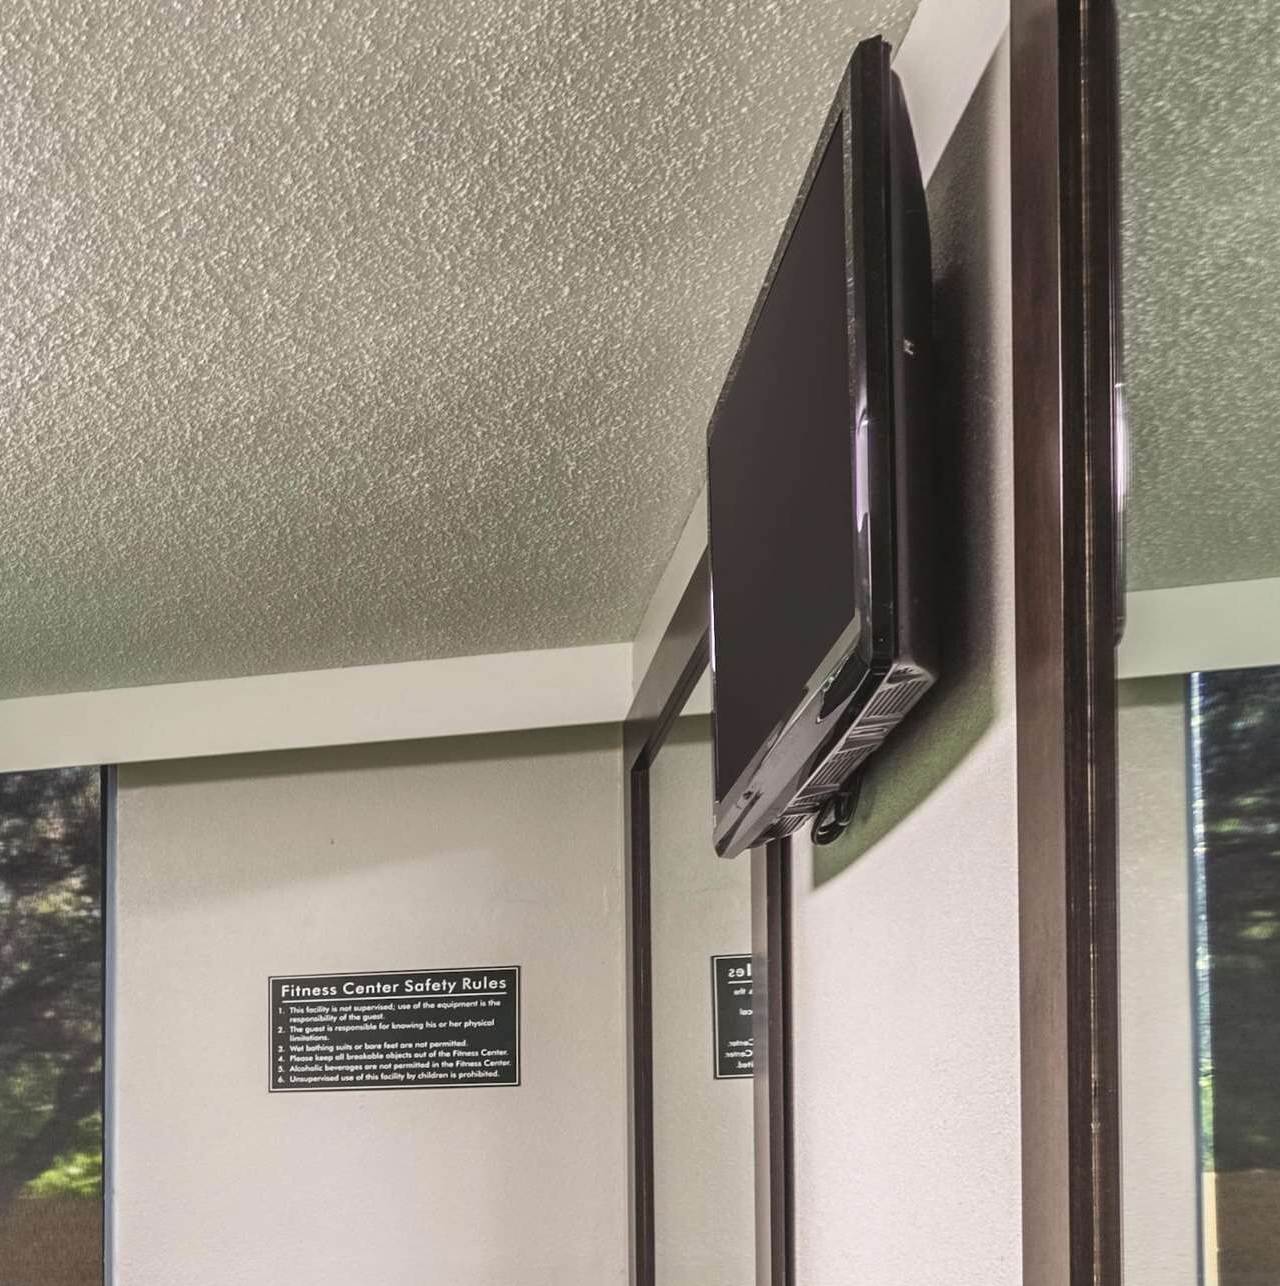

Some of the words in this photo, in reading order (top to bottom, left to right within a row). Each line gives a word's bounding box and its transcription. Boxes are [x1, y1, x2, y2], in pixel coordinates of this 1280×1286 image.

[282, 982, 337, 997] Fitness
[342, 980, 399, 995] Center
[404, 977, 456, 995] Safety
[462, 975, 506, 990] Rules
[289, 1006, 304, 1014] This
[305, 1005, 329, 1014] facility
[412, 1001, 421, 1009] of
[436, 1000, 478, 1009] equipment
[289, 1014, 337, 1024] responsibility
[338, 1013, 347, 1021] of
[289, 1025, 303, 1033] The
[304, 1025, 325, 1034] guest
[326, 1024, 333, 1032] is
[334, 1022, 377, 1032] responsible
[378, 1022, 389, 1030] for
[391, 1021, 423, 1031] knowing
[425, 1020, 436, 1028] his
[463, 1018, 494, 1028] physical
[277, 1045, 284, 1053] 3.
[289, 1044, 304, 1052] Wet
[305, 1043, 334, 1053] bathing
[364, 1042, 382, 1050] bare
[383, 1041, 398, 1049] feet
[289, 1054, 313, 1062] Please
[314, 1053, 333, 1062] keep
[345, 1051, 383, 1060] breakable
[385, 1051, 412, 1060] objects
[452, 1048, 478, 1057] Fitness
[289, 1064, 322, 1072] Alcoholic
[324, 1062, 362, 1073] beverages
[393, 1061, 430, 1070] permitted
[441, 1060, 453, 1068] the
[455, 1059, 481, 1067] Fitness
[277, 1075, 285, 1083] 6.
[289, 1074, 339, 1084] Unsupervised
[380, 1072, 405, 1081] facility
[406, 1072, 416, 1080] by
[417, 1071, 448, 1079] children
